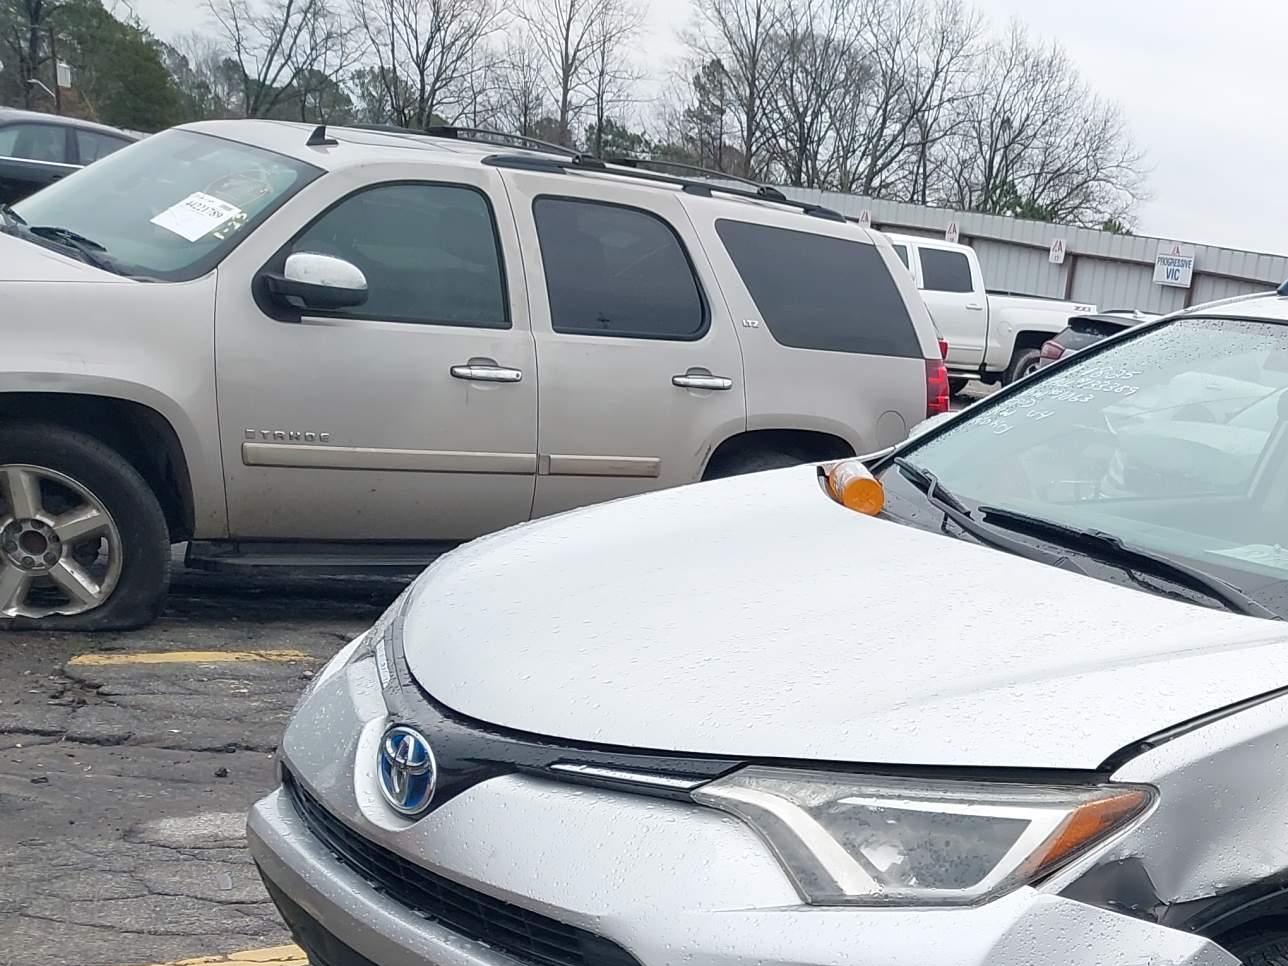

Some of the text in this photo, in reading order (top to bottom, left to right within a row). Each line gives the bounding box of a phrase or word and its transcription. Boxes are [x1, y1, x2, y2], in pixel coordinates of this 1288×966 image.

[1157, 256, 1192, 268] PROGRESSIVE
[1166, 266, 1180, 281] VIC
[742, 319, 759, 328] LTZ
[260, 430, 331, 443] TAHOE
